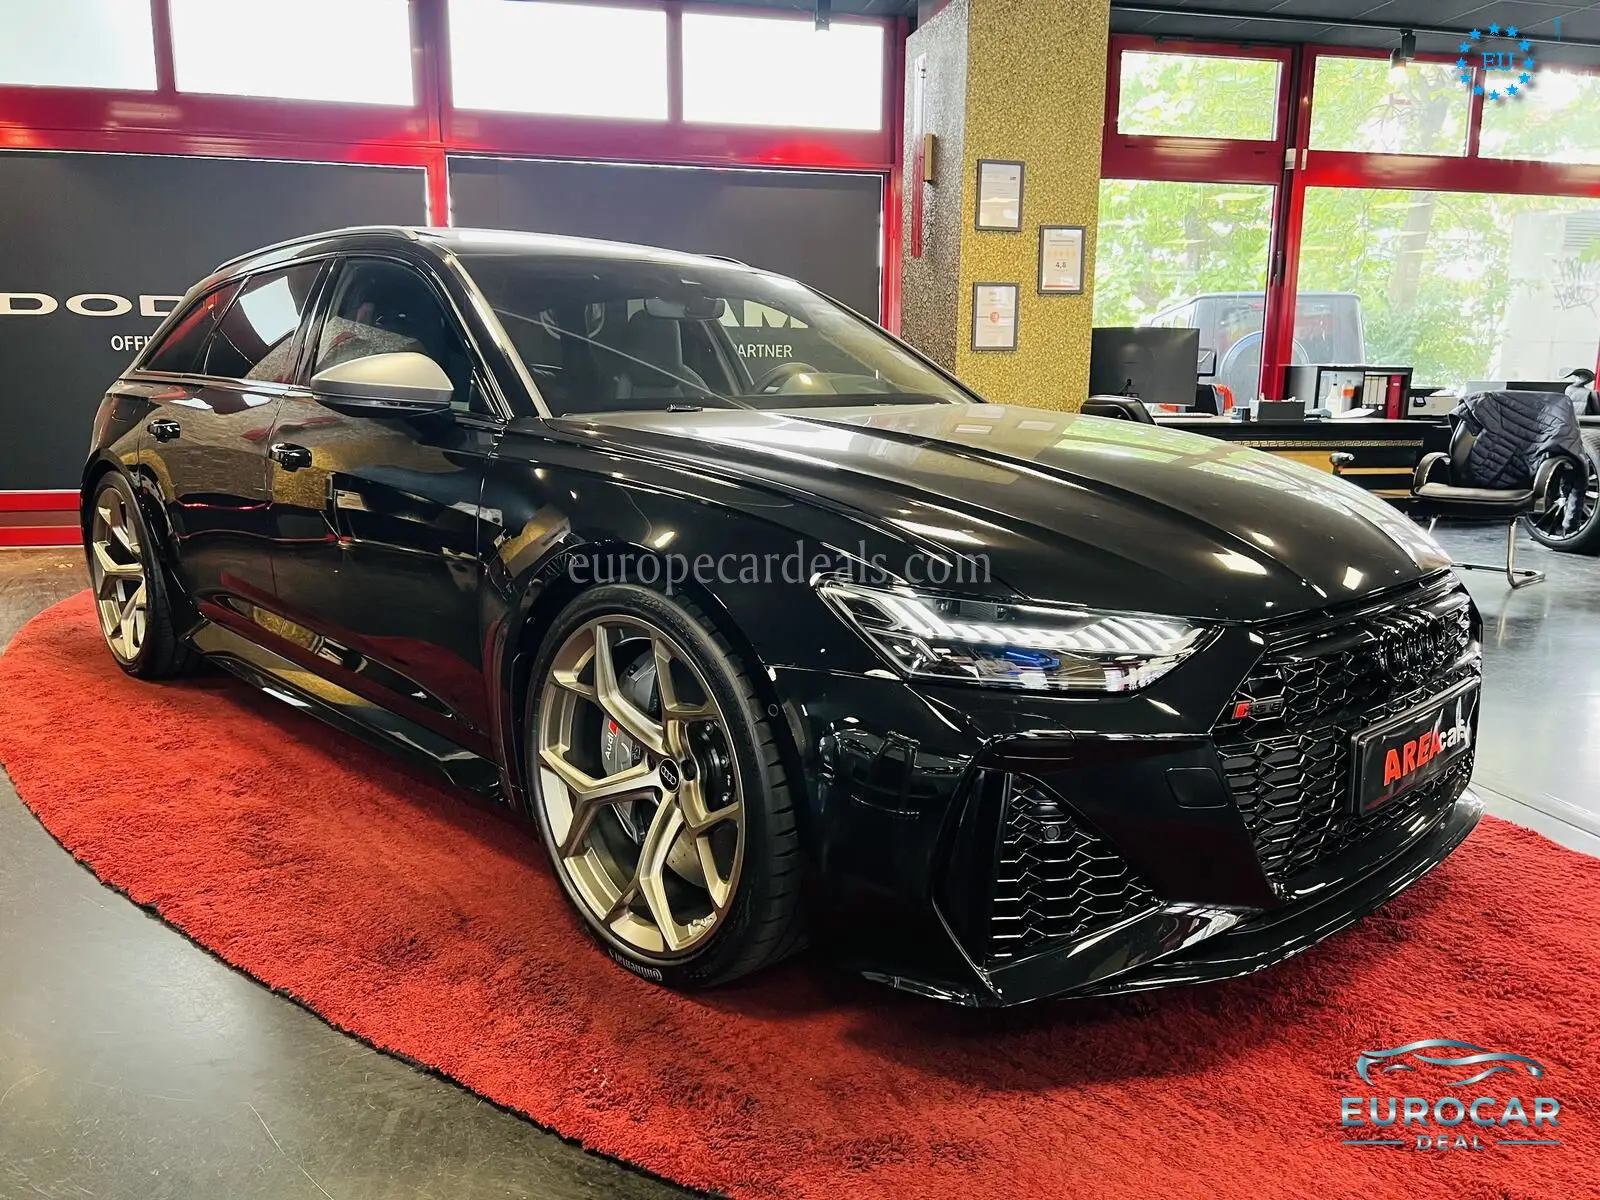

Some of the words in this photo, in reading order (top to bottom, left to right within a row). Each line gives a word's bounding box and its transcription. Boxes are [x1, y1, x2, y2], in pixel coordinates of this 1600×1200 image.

[110, 335, 152, 351] OFFI
[734, 344, 793, 358] ARTNER
[605, 731, 615, 761] Audi
